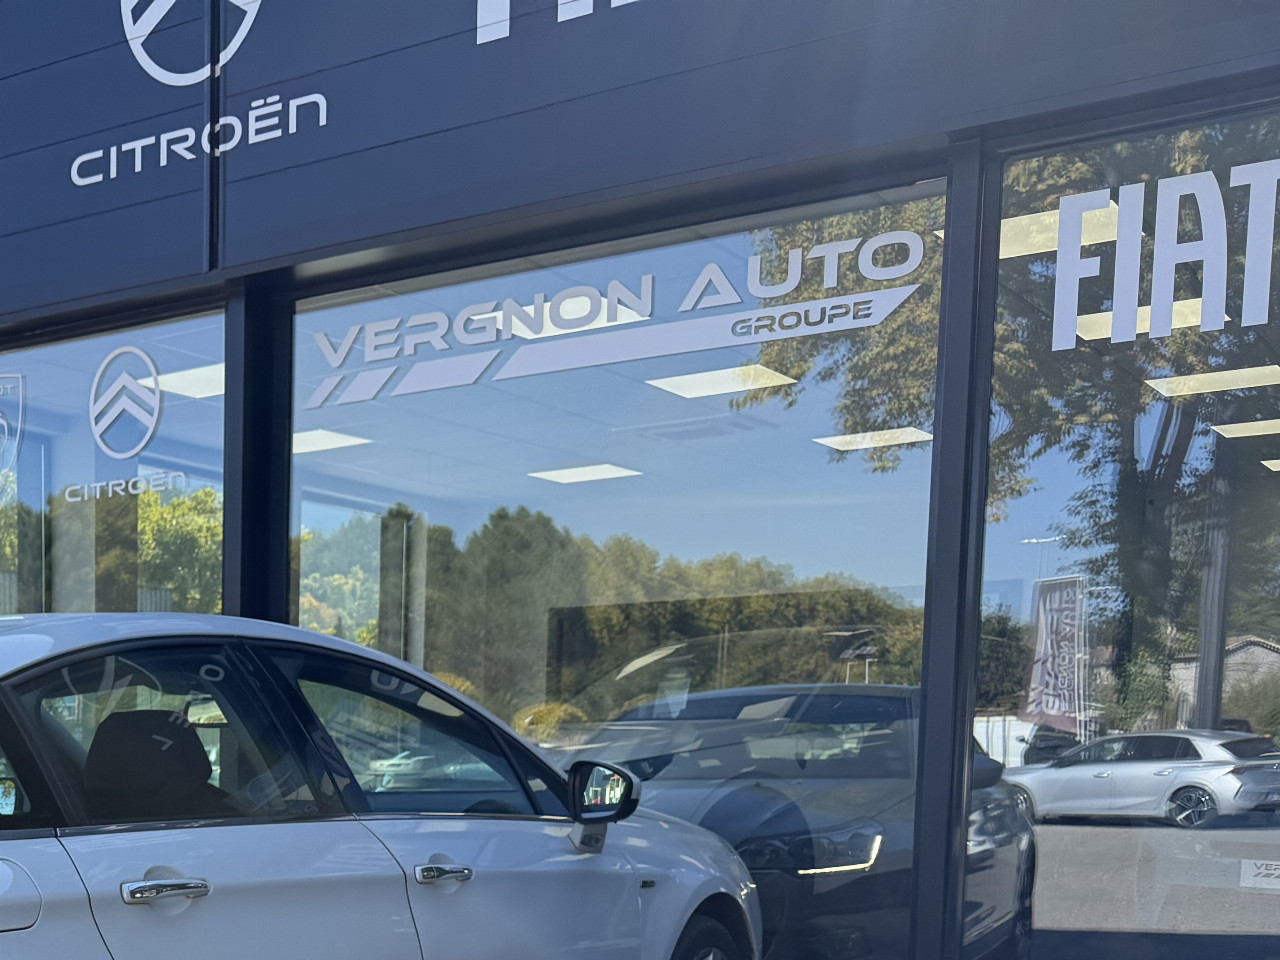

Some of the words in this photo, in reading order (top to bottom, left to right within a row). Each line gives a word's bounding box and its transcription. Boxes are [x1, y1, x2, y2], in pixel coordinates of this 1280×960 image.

[313, 273, 653, 369] VERGNON
[678, 230, 925, 312] AUTO
[730, 299, 874, 337] GROUPE
[1052, 159, 1280, 352] FIAT
